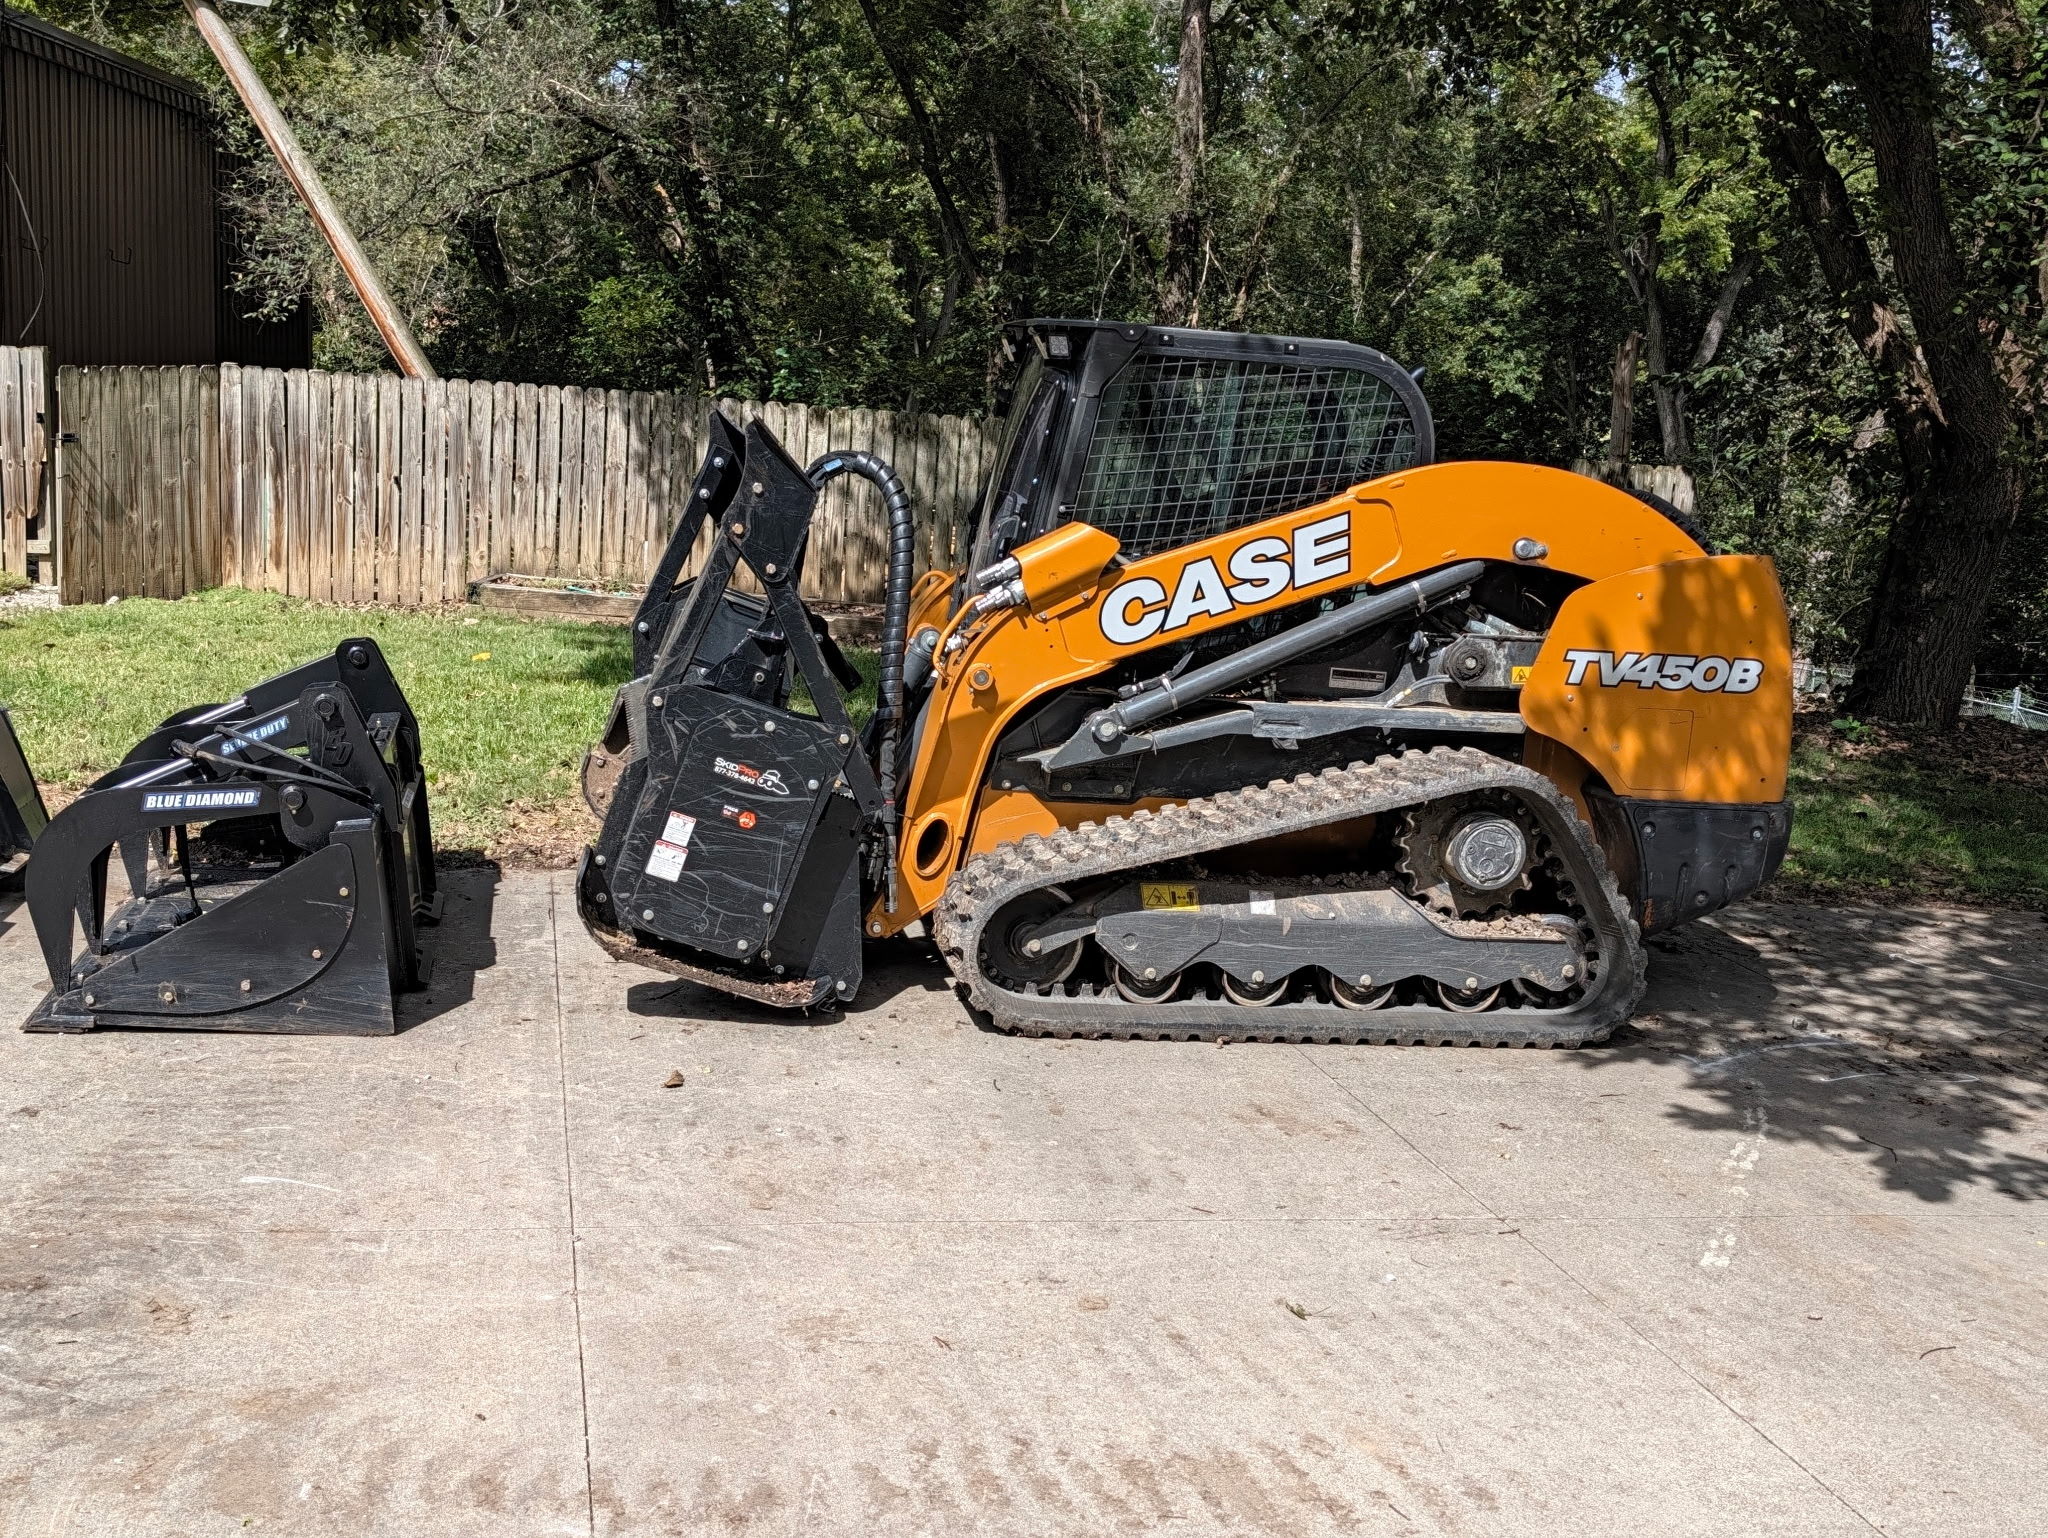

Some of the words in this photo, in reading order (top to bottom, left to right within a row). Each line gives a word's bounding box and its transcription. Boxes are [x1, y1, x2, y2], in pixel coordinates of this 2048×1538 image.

[1099, 511, 1351, 646] CASE
[1563, 648, 1765, 694] TV450B
[260, 717, 287, 738] DUTY
[714, 757, 759, 779] SKIDPRO
[146, 795, 182, 808] BLUE
[185, 791, 256, 806] DIAMOND
